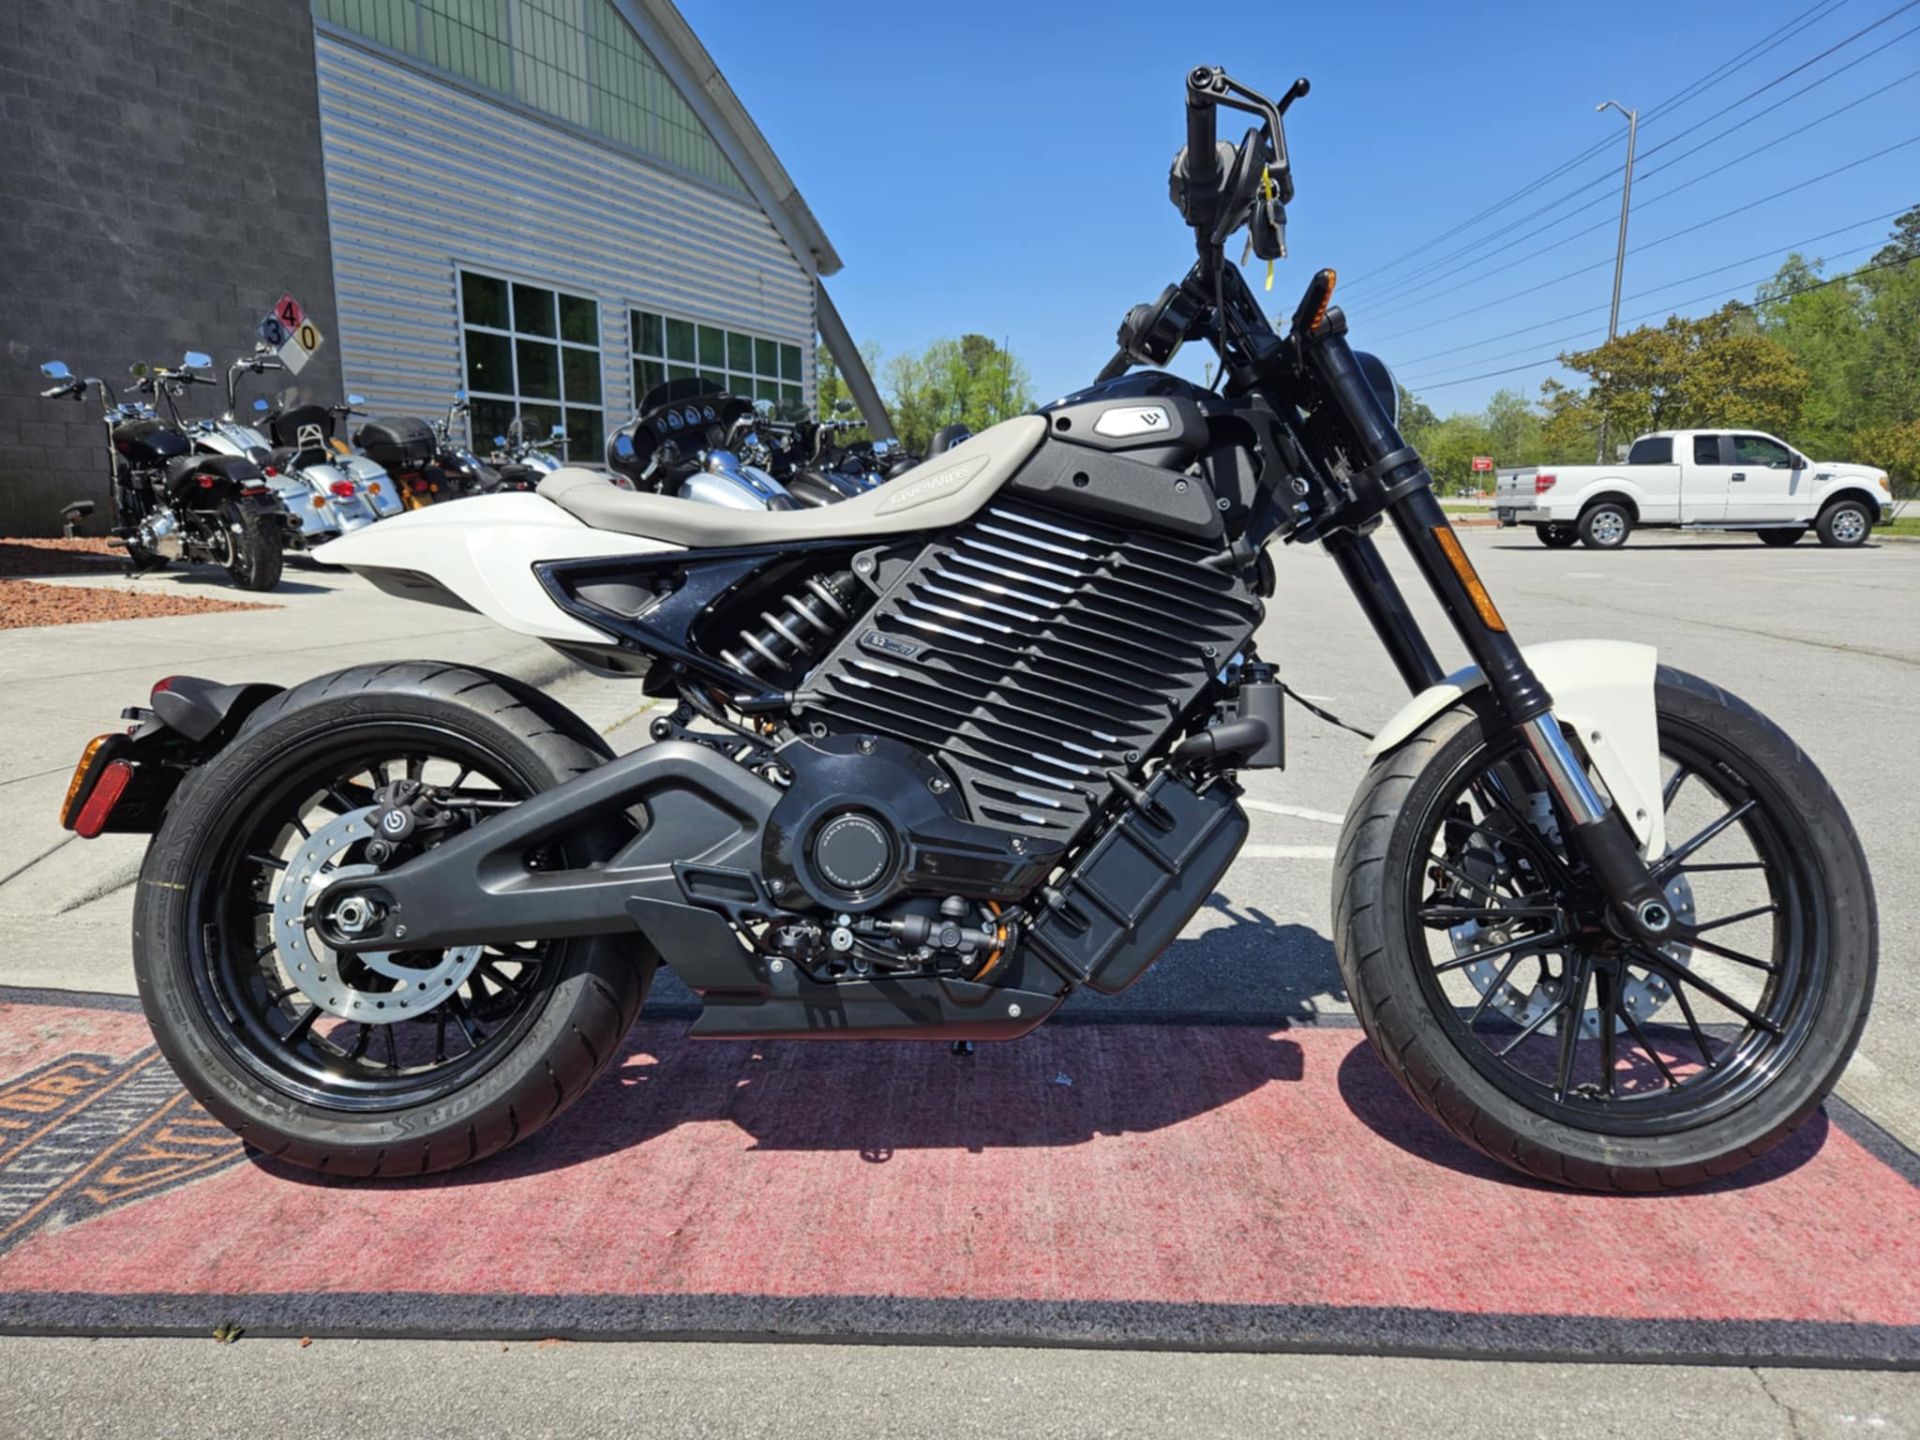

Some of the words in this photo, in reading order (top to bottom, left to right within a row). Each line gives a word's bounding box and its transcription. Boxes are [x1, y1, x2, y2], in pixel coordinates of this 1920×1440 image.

[282, 301, 297, 326] 4
[266, 318, 281, 346] 3
[302, 325, 315, 350] 0
